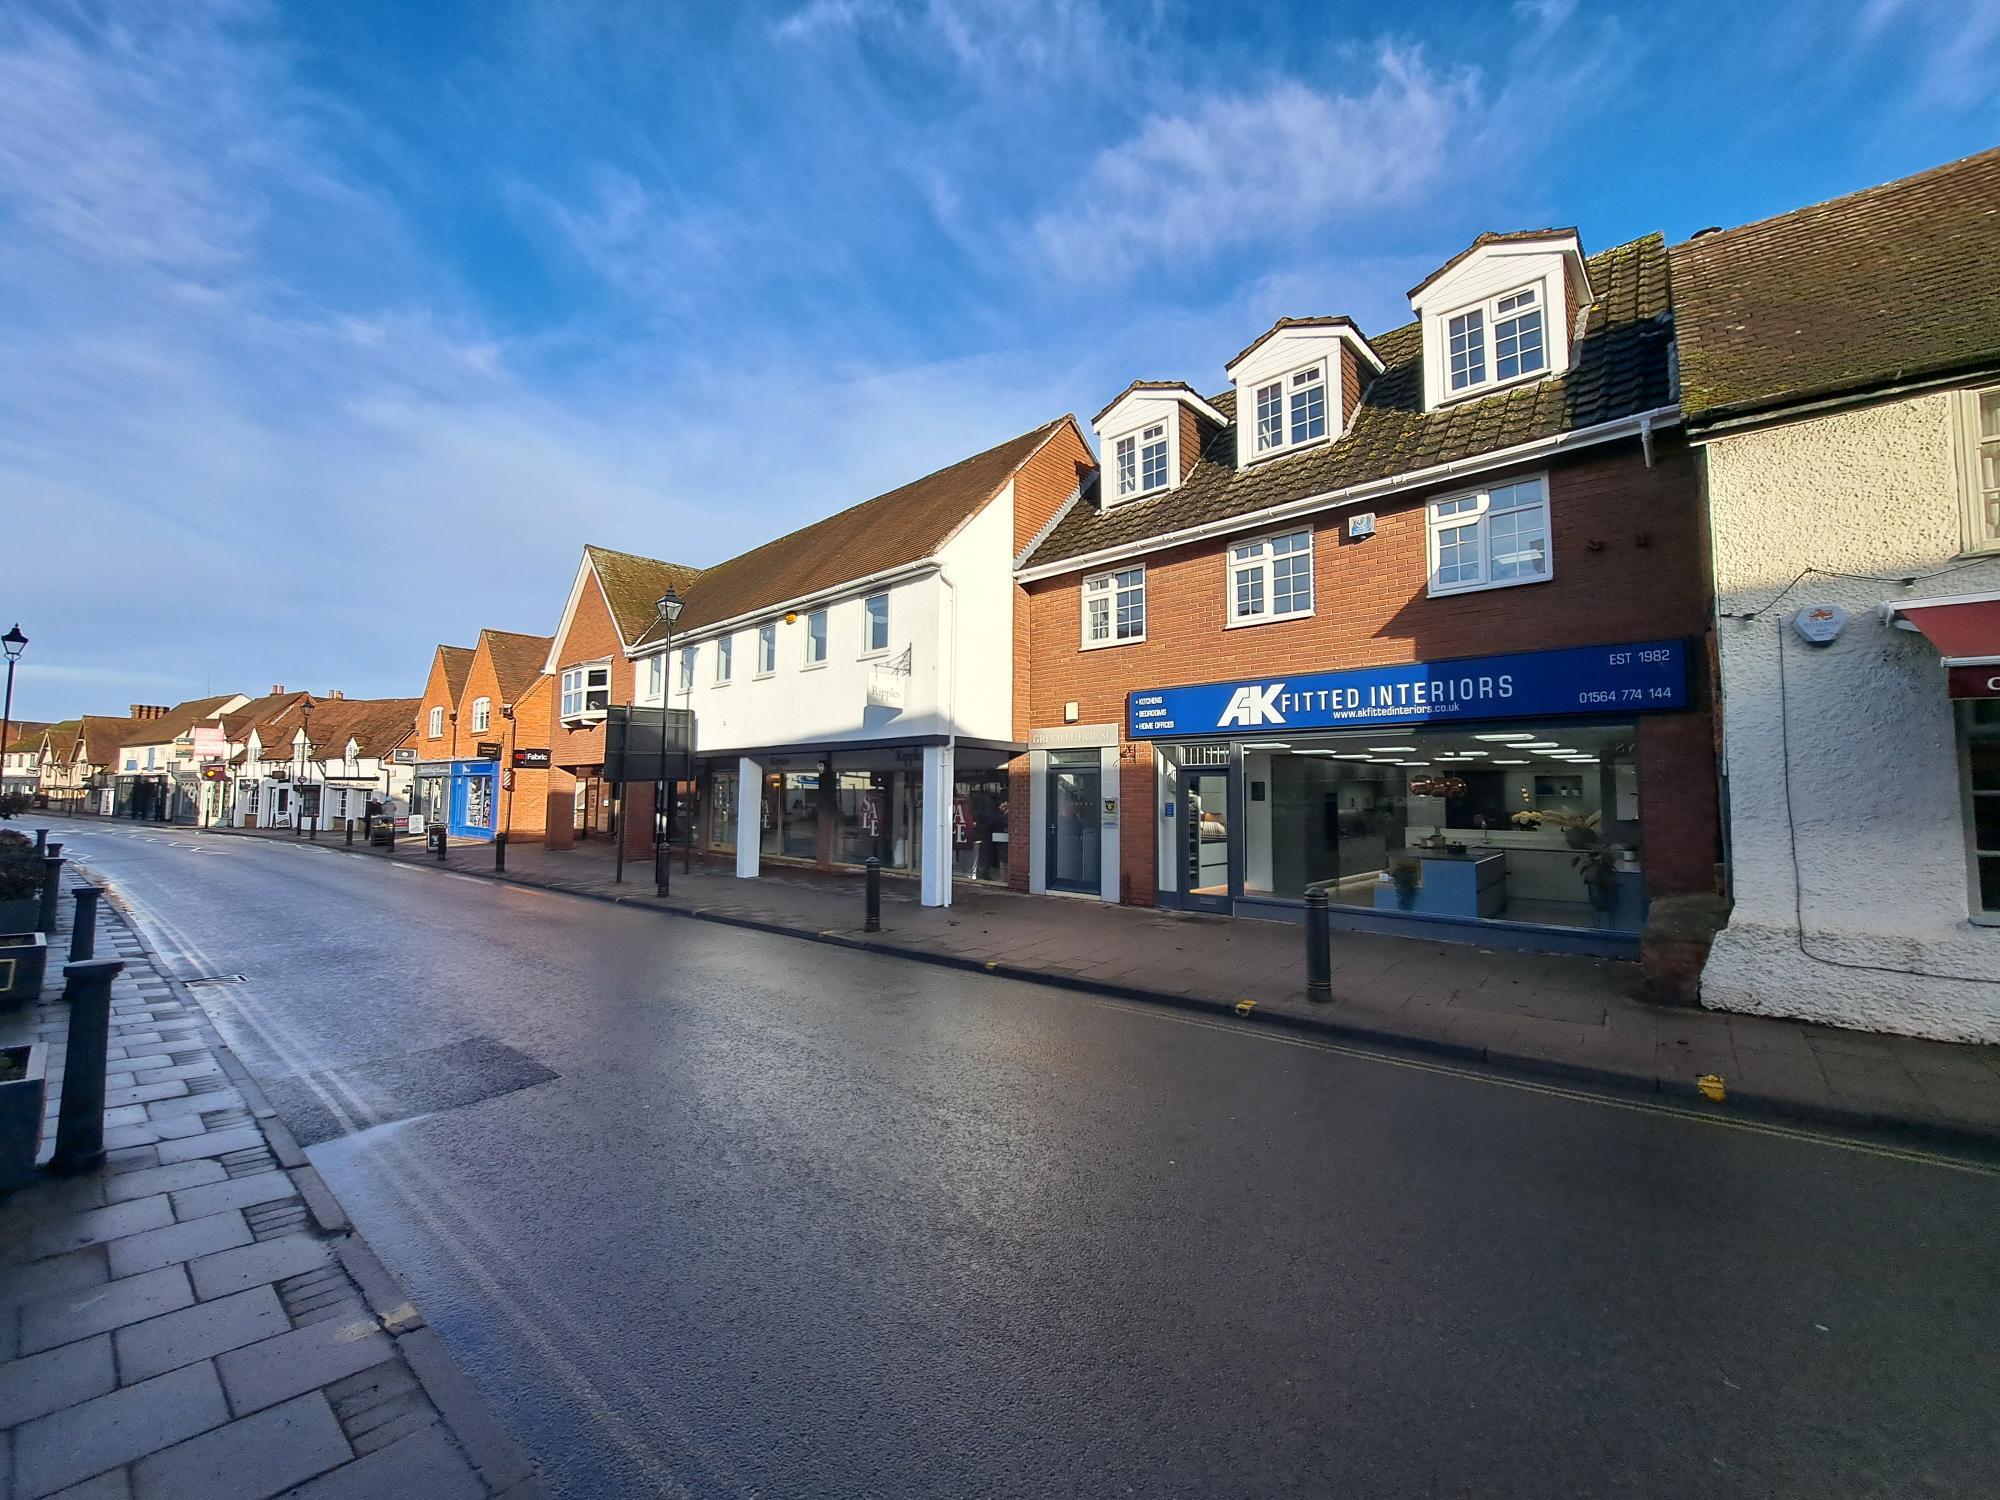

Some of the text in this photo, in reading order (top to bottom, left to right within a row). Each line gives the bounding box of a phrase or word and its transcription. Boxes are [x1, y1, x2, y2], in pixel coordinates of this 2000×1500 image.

[1609, 649, 1670, 665] EST 1982
[1139, 696, 1163, 705] KITCHENS
[1216, 675, 1513, 727] AK FITTED INTERIORS
[1579, 686, 1672, 703] 01564 774 144
[1139, 709, 1167, 718] BEDROOMS
[1333, 702, 1460, 719] www.akfittedinteriors.co.uk
[1139, 720, 1175, 730] HOME OFFICES
[527, 752, 549, 761] Fabric
